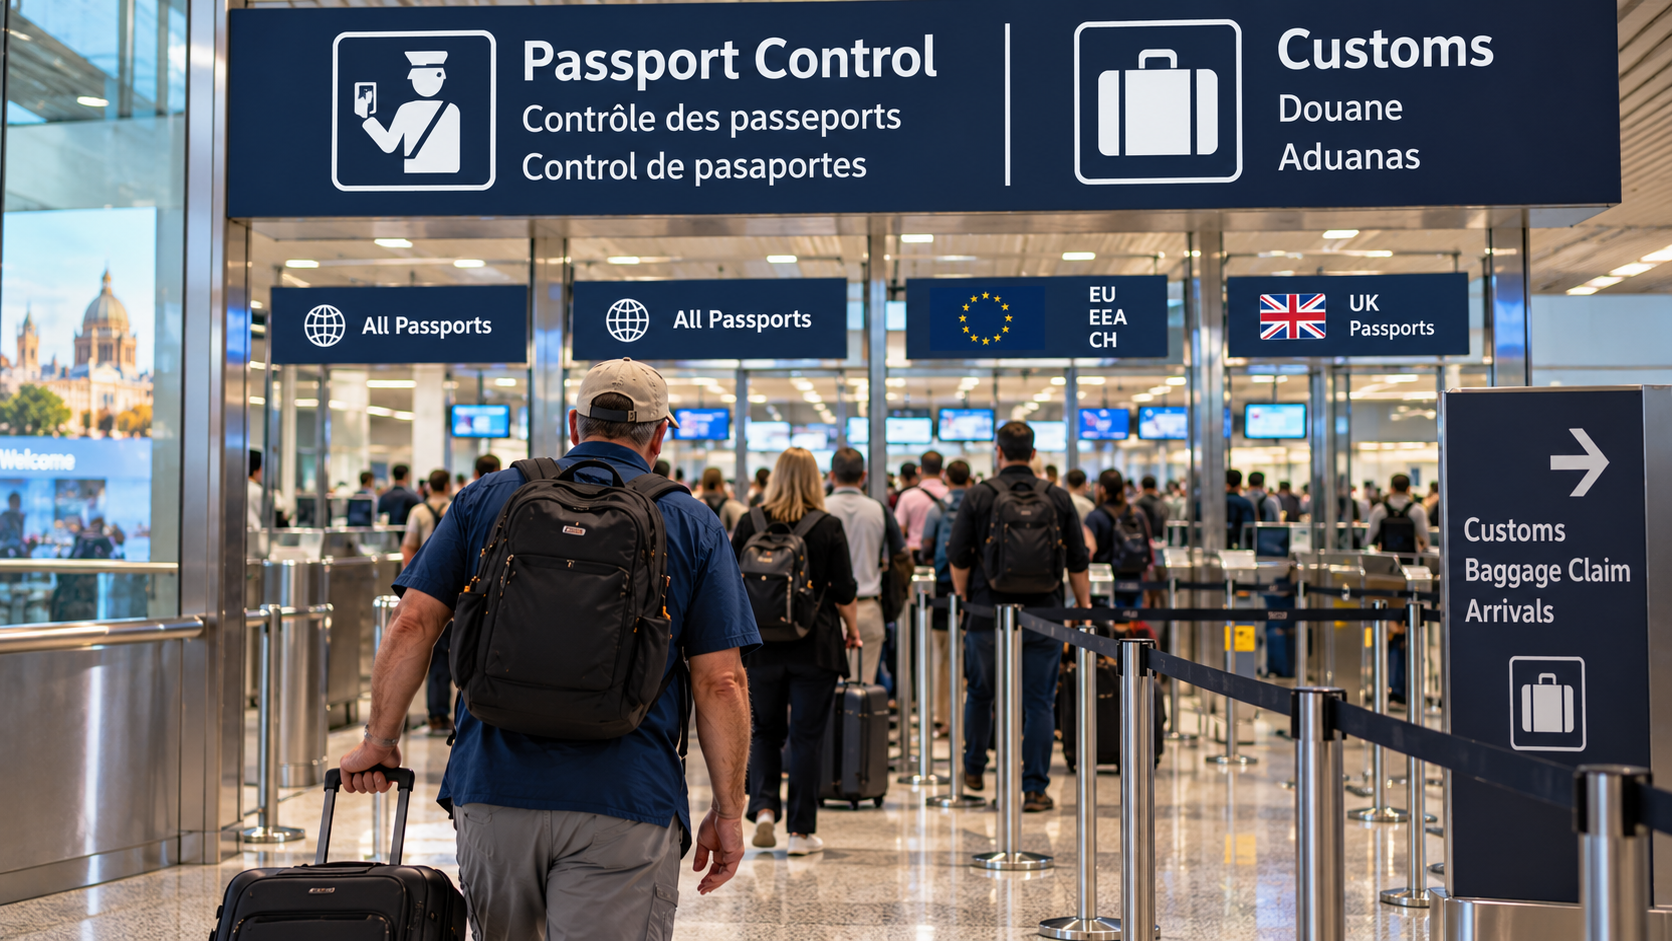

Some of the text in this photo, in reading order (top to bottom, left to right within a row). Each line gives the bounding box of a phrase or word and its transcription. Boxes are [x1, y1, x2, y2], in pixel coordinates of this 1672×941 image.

[1277, 27, 1494, 70] Customs
[524, 33, 938, 92] Passport Control
[522, 102, 902, 139] Contrôle des passeports
[1279, 93, 1403, 123] Douane
[522, 151, 867, 187] Control de pasaportes
[1277, 141, 1421, 171] Aduanas
[1089, 285, 1116, 303] EU
[1349, 293, 1380, 312] UK
[361, 315, 492, 340] All Passports
[672, 309, 812, 334] All Passports
[1089, 308, 1128, 326] EEA
[1350, 320, 1435, 341] Passports
[1089, 331, 1117, 349] CH
[0, 448, 76, 471] Welcome
[1464, 516, 1566, 543] Customs
[1465, 557, 1631, 589] Baggage Claim
[1464, 597, 1555, 624] Arrivals
